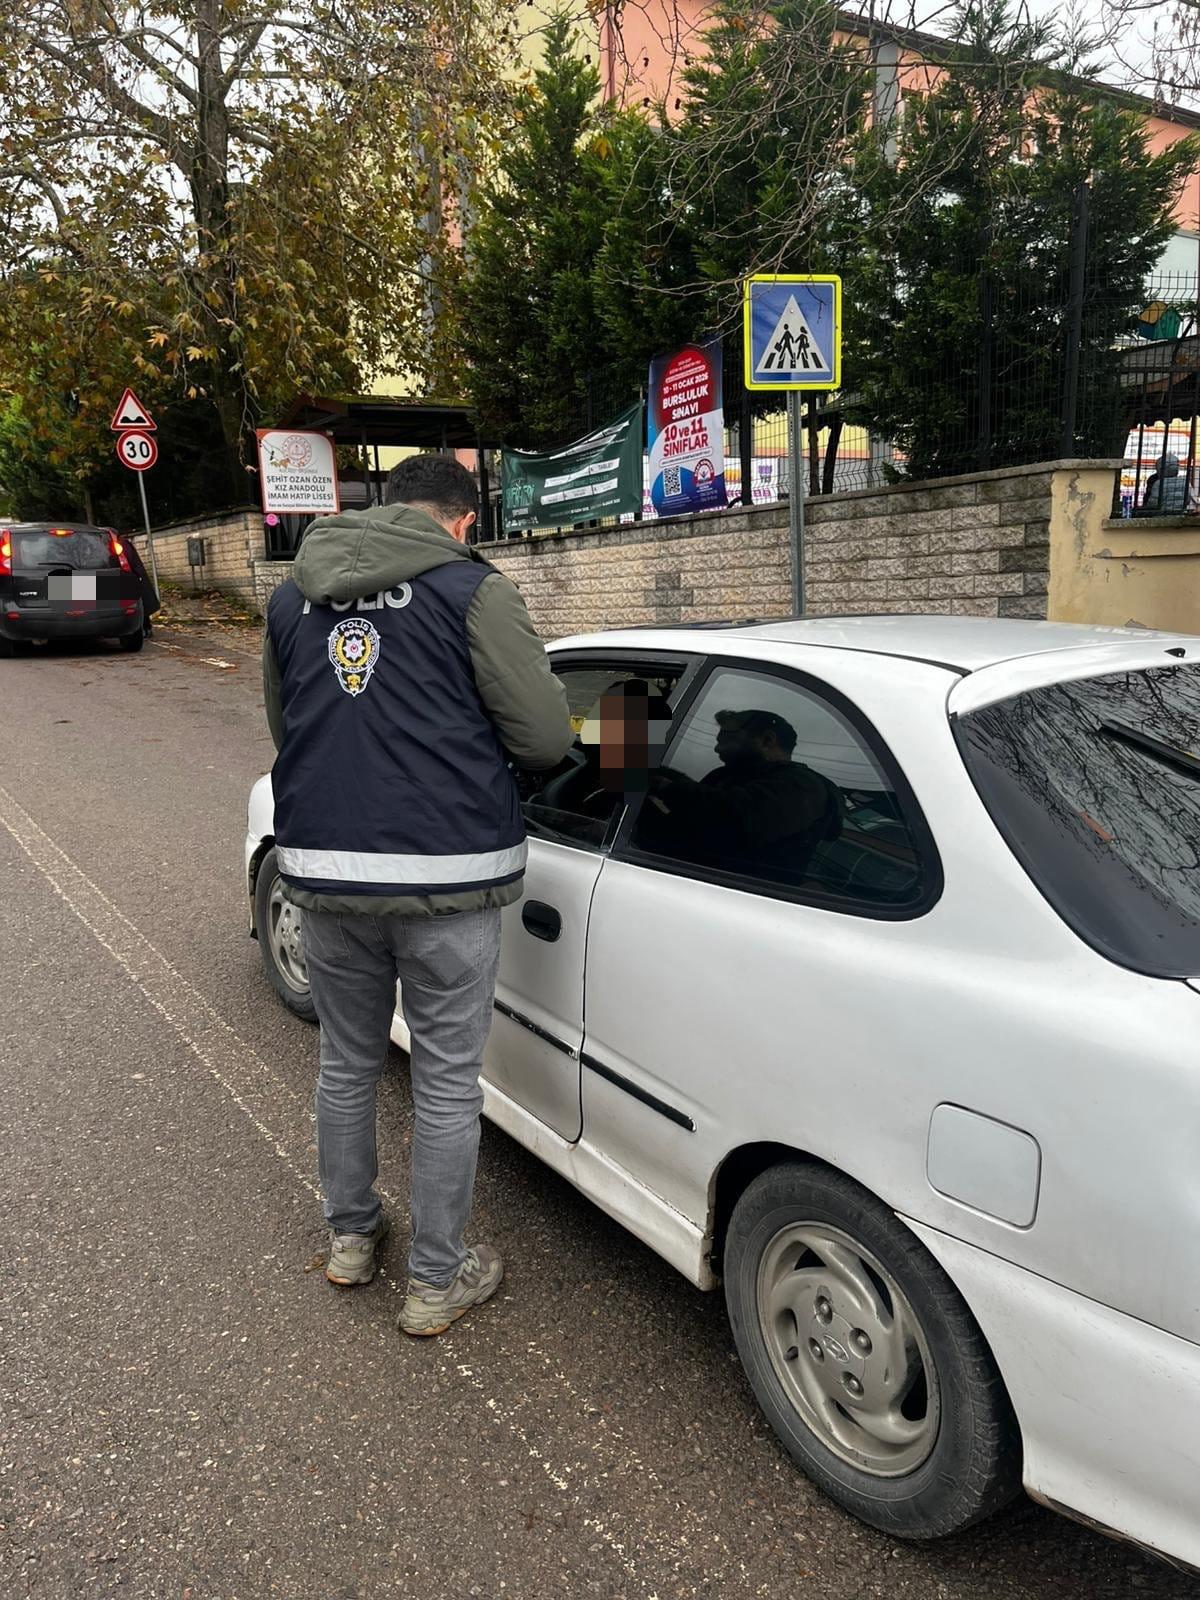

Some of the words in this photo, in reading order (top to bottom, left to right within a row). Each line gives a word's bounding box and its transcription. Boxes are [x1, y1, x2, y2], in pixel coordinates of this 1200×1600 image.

[678, 376, 695, 389] OCAK
[662, 384, 709, 410] BURSLULUK
[672, 402, 699, 420] SINAVI
[664, 425, 678, 442] 10
[679, 426, 690, 438] ve
[126, 441, 149, 459] 30
[663, 432, 709, 457] SINIFLAR
[266, 474, 287, 483] ŞEHİT
